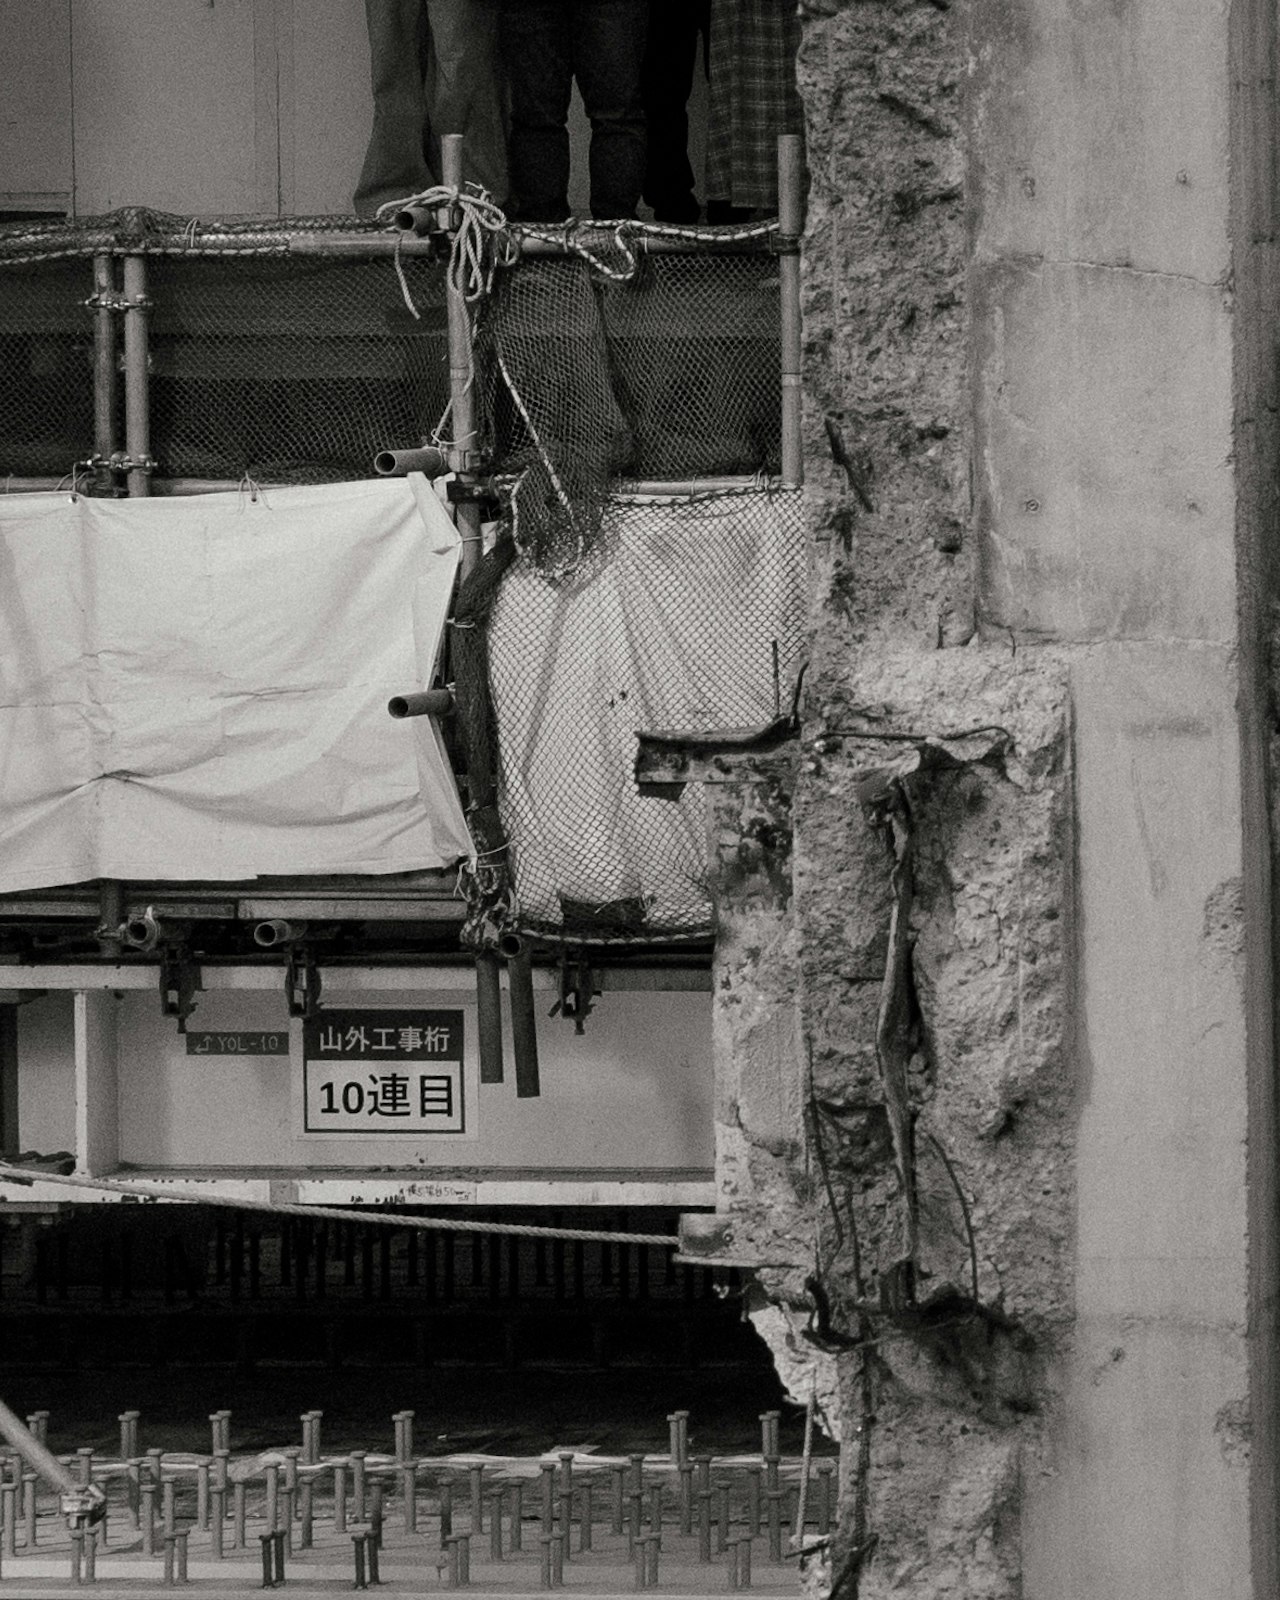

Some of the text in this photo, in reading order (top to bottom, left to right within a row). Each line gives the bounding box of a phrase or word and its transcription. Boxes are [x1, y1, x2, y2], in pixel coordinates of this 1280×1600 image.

[318, 1025, 452, 1053] 山外工事桁
[319, 1073, 454, 1119] 10連目
